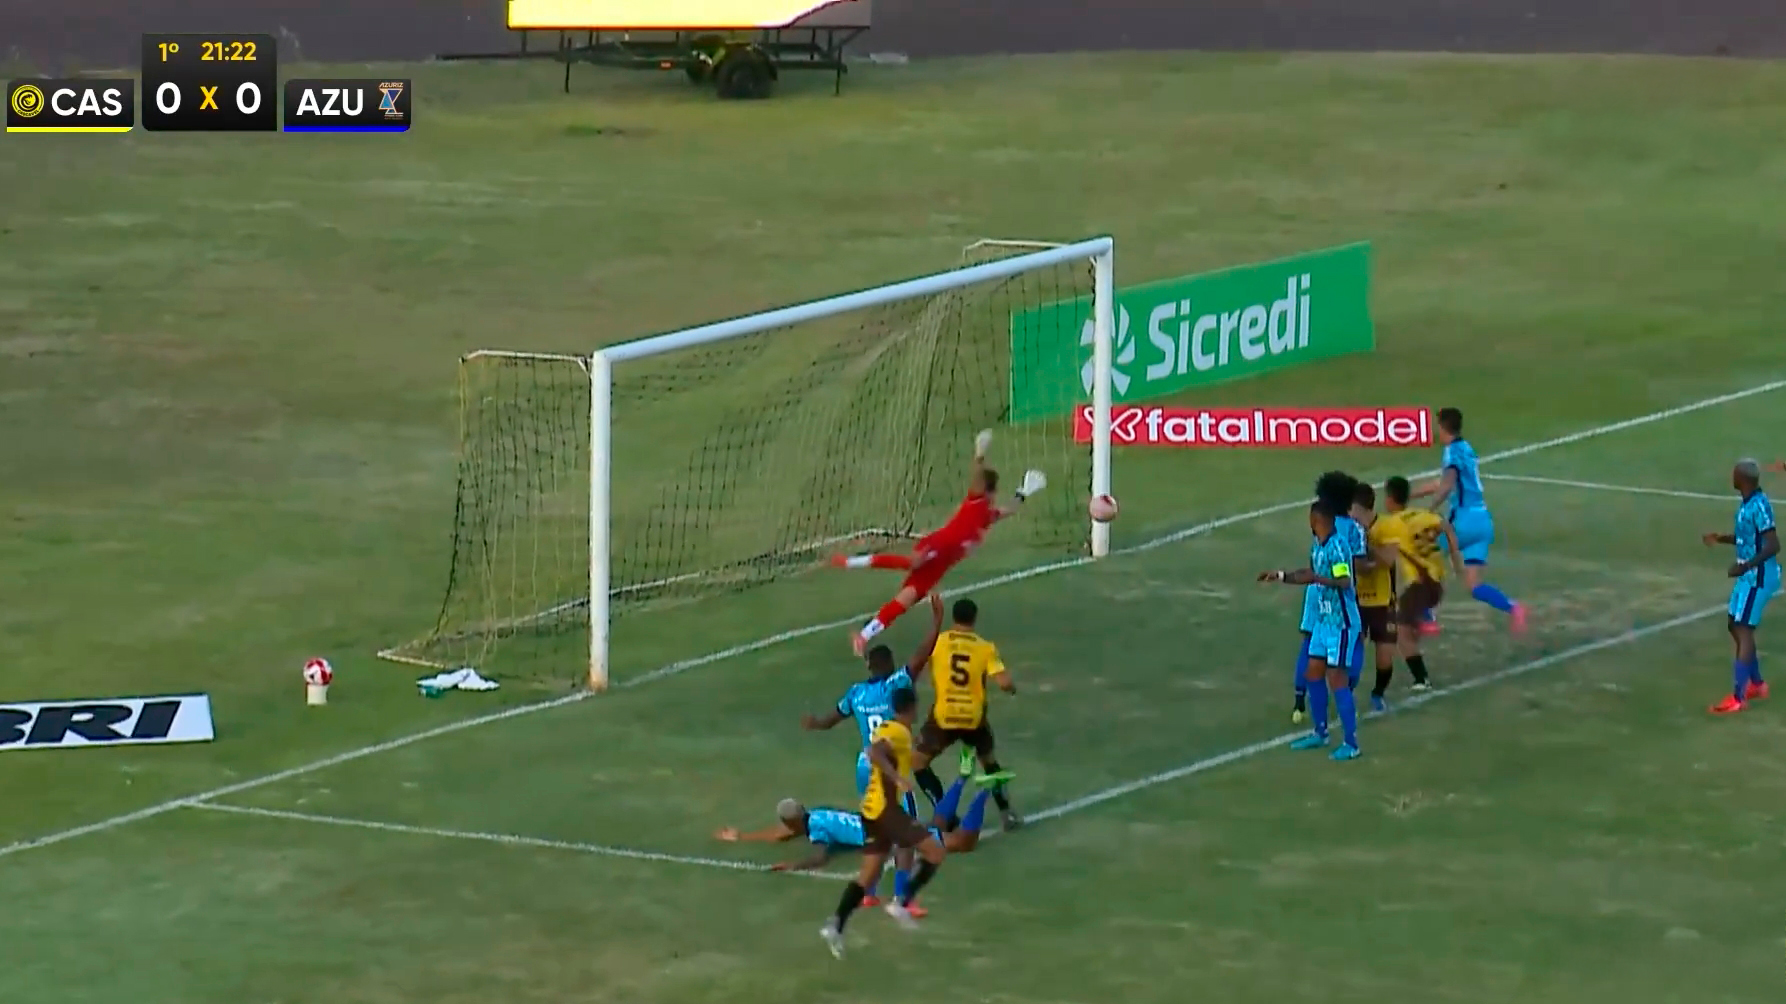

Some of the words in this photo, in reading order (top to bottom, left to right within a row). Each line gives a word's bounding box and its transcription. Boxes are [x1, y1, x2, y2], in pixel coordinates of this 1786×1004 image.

[1146, 273, 1310, 381] Sicredi
[1146, 409, 1427, 443] fatalmodel
[950, 653, 971, 687] 5
